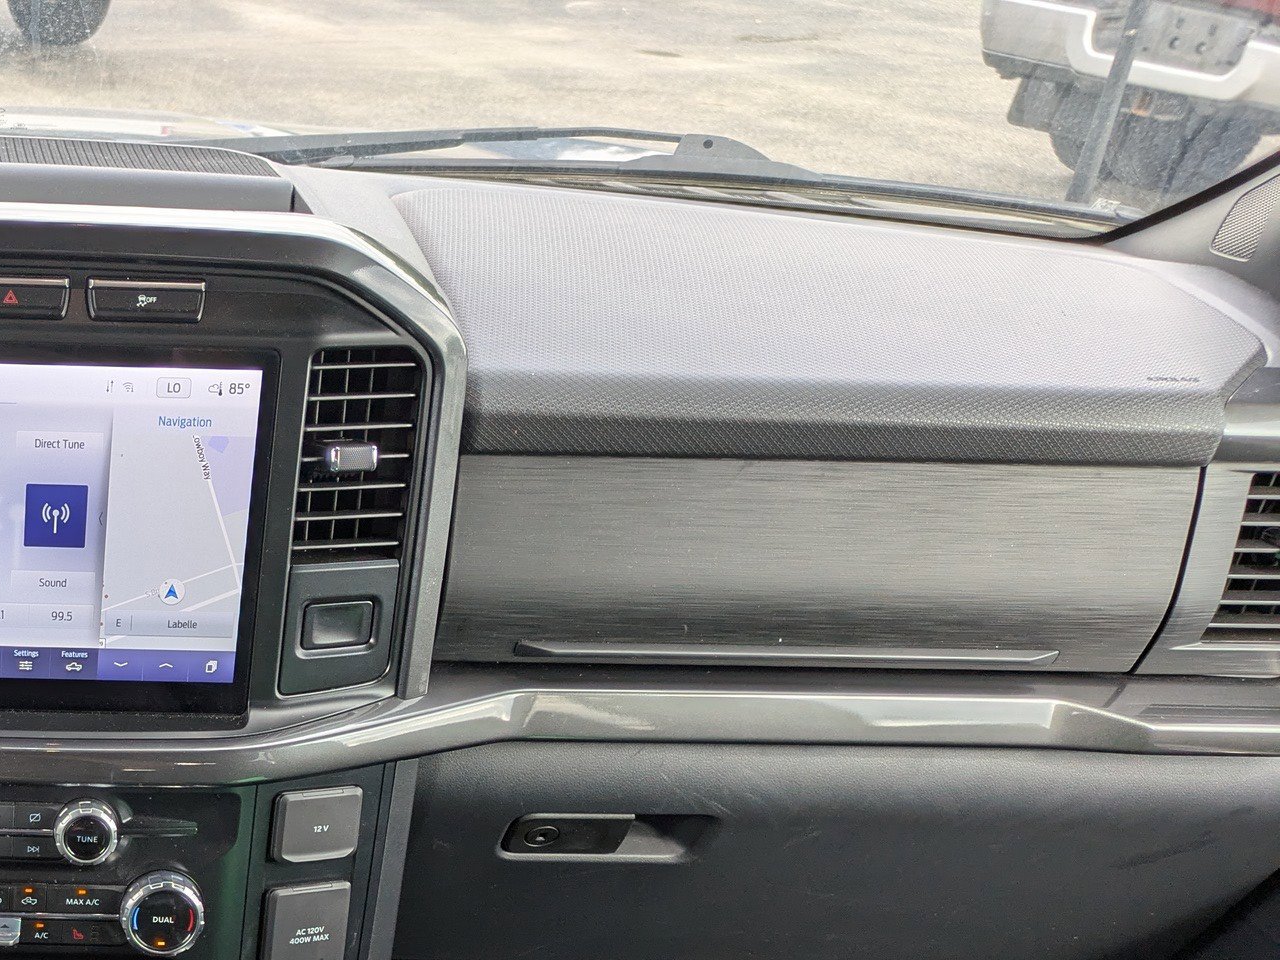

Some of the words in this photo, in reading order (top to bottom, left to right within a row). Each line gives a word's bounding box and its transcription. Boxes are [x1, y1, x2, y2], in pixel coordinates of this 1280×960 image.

[167, 383, 180, 393] LO
[228, 382, 250, 394] 85°
[158, 416, 212, 428] Navigation
[34, 438, 60, 448] Direct
[62, 439, 85, 449] Tune
[202, 463, 210, 480] Way
[39, 578, 67, 588] Sound
[51, 611, 72, 621] 99.5
[116, 618, 121, 627] E
[167, 620, 197, 629] Labelle
[313, 825, 322, 833] 12
[296, 928, 306, 936] AC
[307, 925, 324, 934] 120V
[289, 935, 311, 944] 400W
[312, 933, 329, 942] MAX
